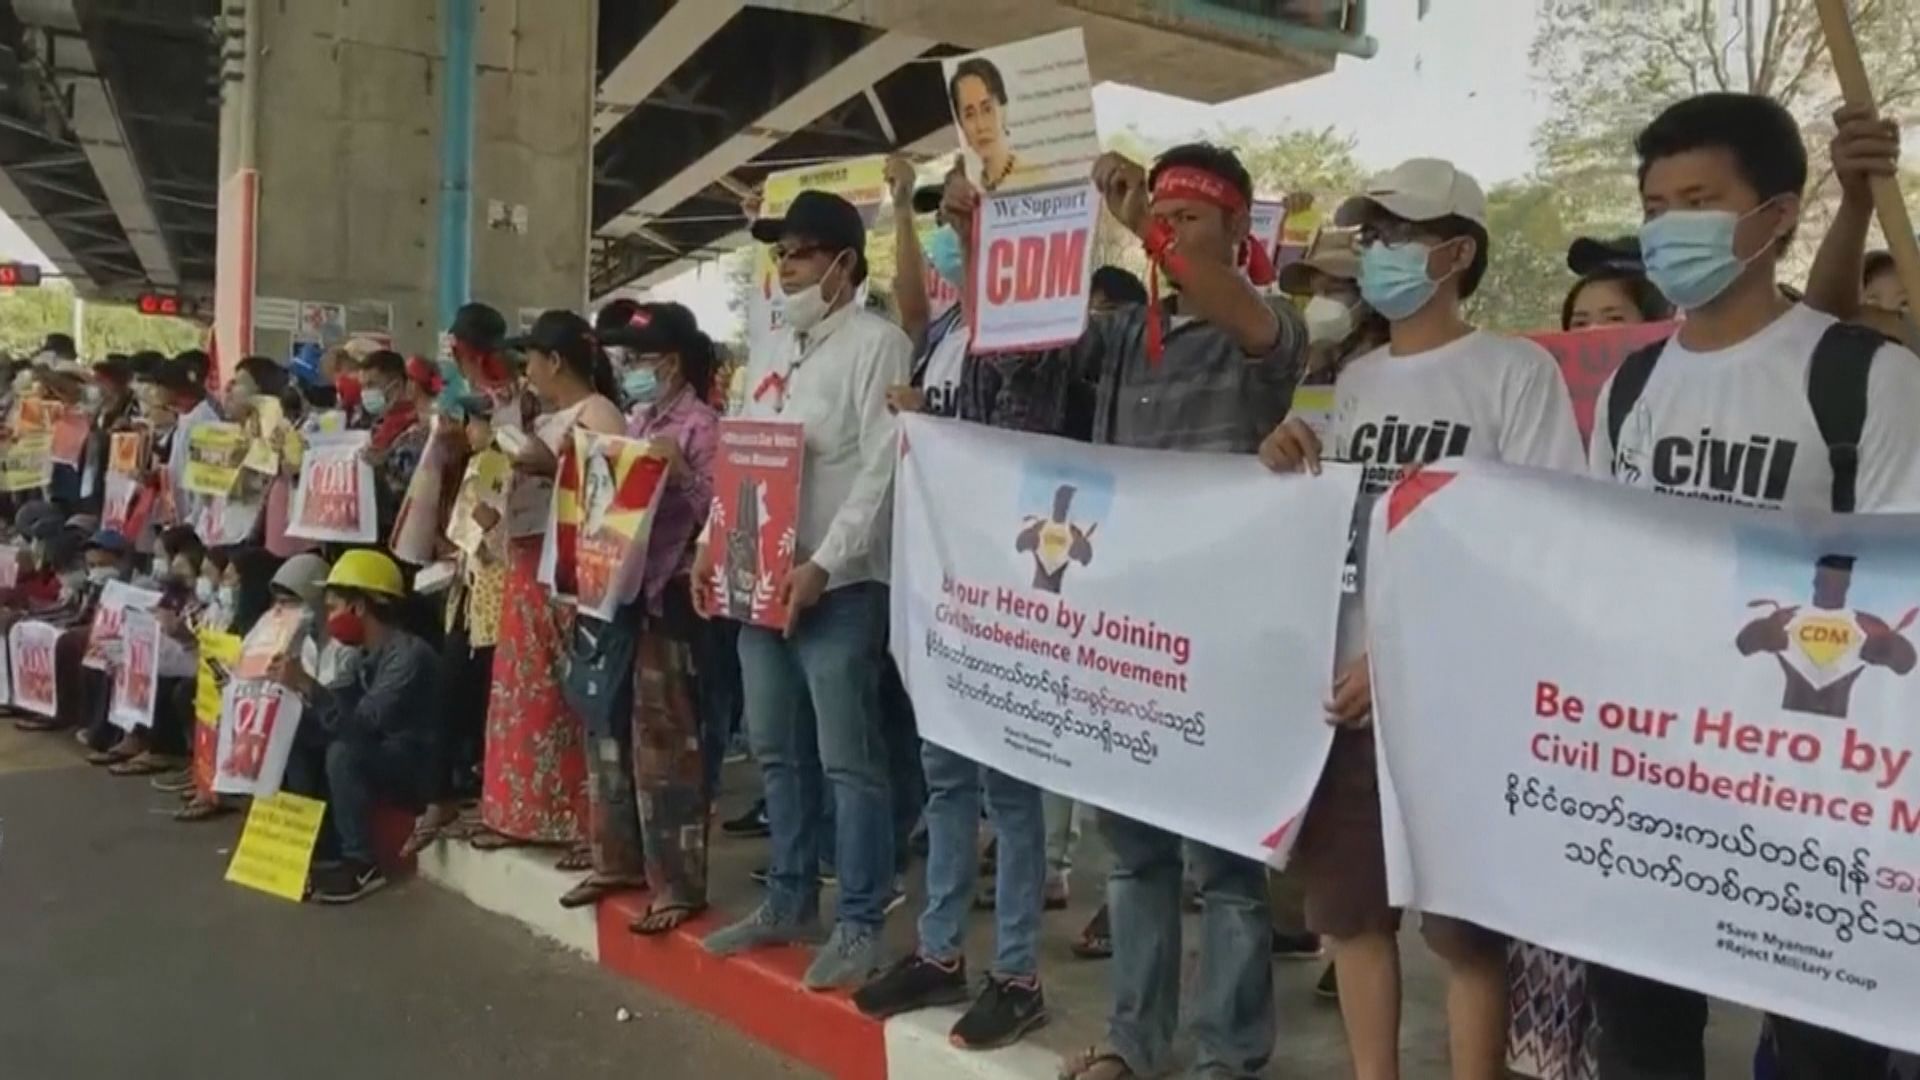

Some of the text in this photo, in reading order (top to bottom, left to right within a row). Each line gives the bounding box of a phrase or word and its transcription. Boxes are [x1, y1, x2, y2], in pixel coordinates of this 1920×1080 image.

[994, 192, 1087, 217] We Support
[986, 228, 1088, 305] CDM
[996, 586, 1048, 624] Hero
[1057, 600, 1086, 638] by
[1092, 611, 1191, 664] Joining
[1076, 645, 1188, 693] Movement
[1534, 681, 1912, 789] Be our Hero by
[1530, 733, 1599, 773] Civil
[1610, 747, 1875, 827] Disobedience
[1716, 919, 1834, 961] #Save Myanmar
[1716, 937, 1878, 992] #Reject Military Coup
